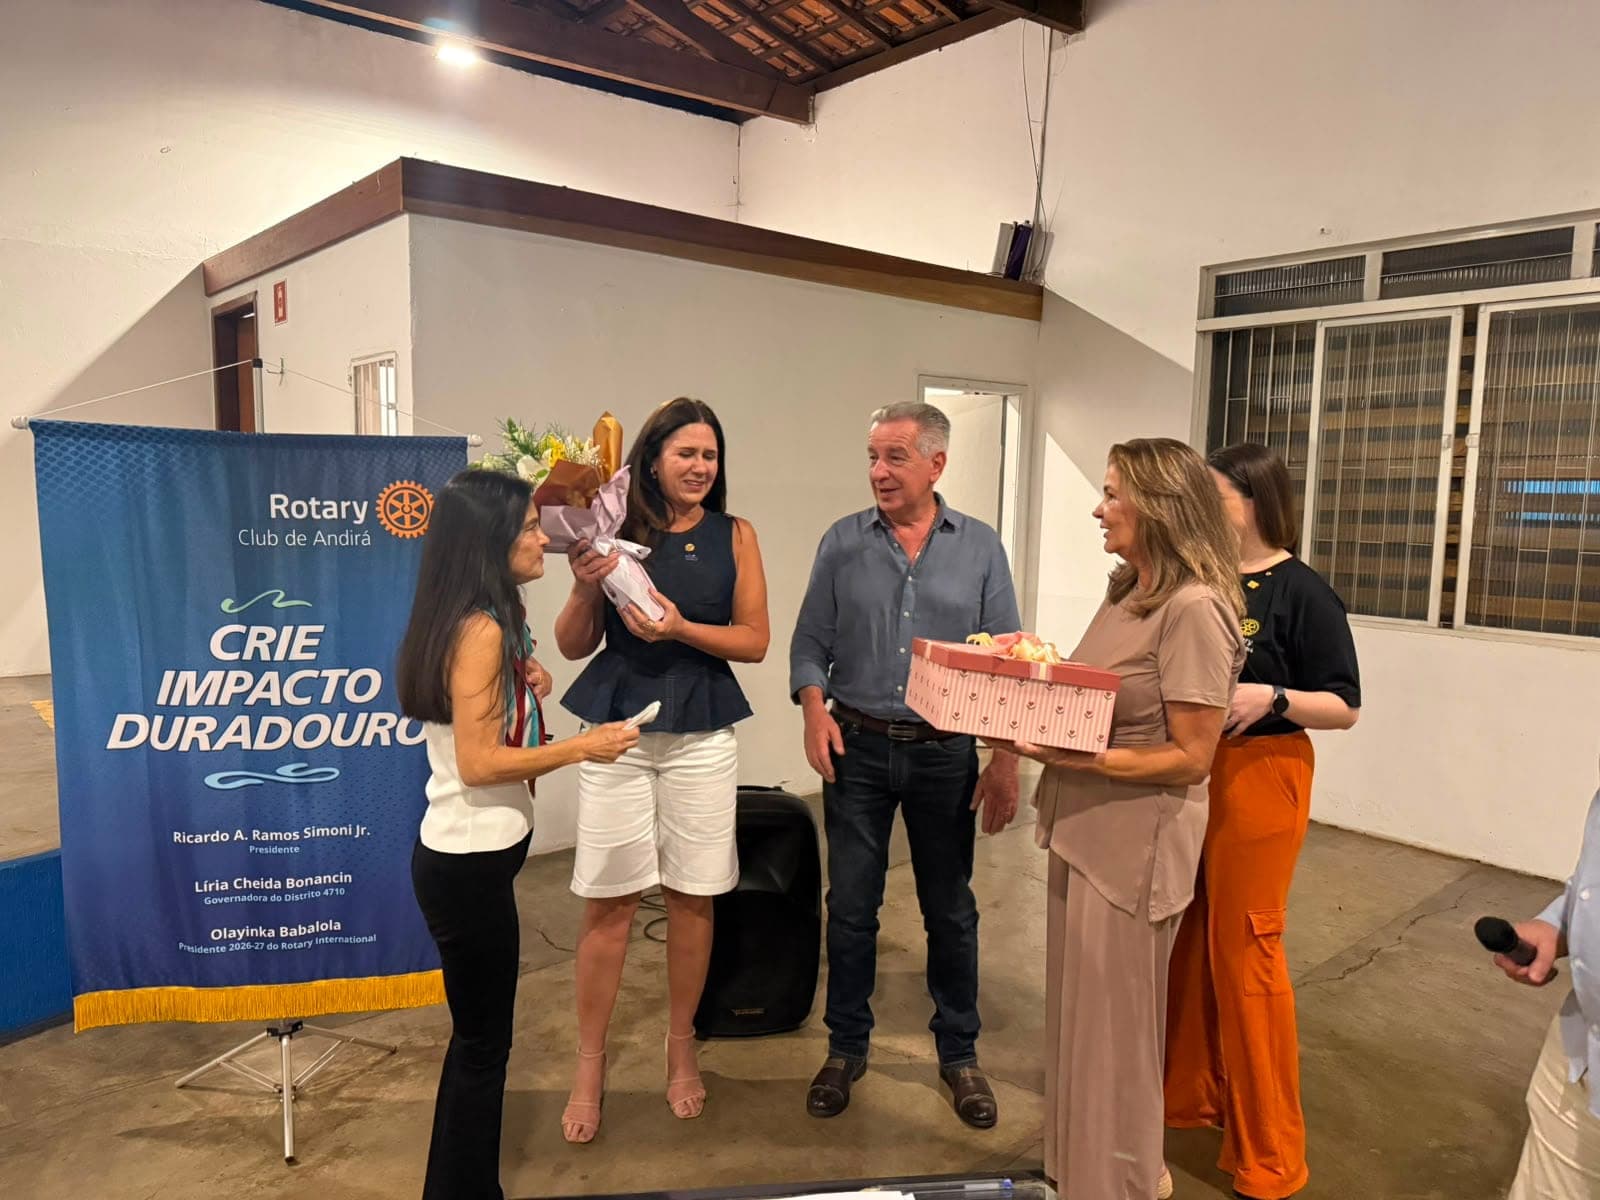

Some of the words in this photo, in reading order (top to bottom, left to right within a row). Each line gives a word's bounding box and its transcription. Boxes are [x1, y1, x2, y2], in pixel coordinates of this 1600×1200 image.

[269, 493, 369, 525] Rotary
[238, 529, 279, 546] Club
[285, 530, 307, 546] de
[312, 529, 371, 546] Andirá
[209, 624, 325, 661] CRIE
[156, 668, 382, 706] IMPACTO
[106, 712, 427, 751] DURADOURO
[173, 829, 230, 844] Ricardo
[233, 829, 248, 841] A.
[252, 829, 300, 841] Ramos
[303, 824, 352, 839] Simoni
[354, 824, 371, 838] Jr.
[249, 845, 300, 854] Presidente
[194, 879, 229, 893] Líria
[233, 877, 282, 889] Cheida
[286, 871, 352, 889] Bonancin
[204, 893, 268, 905] Governadora
[270, 893, 282, 902] do
[284, 890, 321, 902] Distrito
[323, 887, 345, 896] 4710
[210, 925, 275, 941] Olayinka
[279, 919, 341, 938] Babalola
[228, 942, 265, 952] 2026-27
[266, 942, 279, 951] do
[281, 939, 313, 950] Rotary
[315, 934, 377, 945] International
